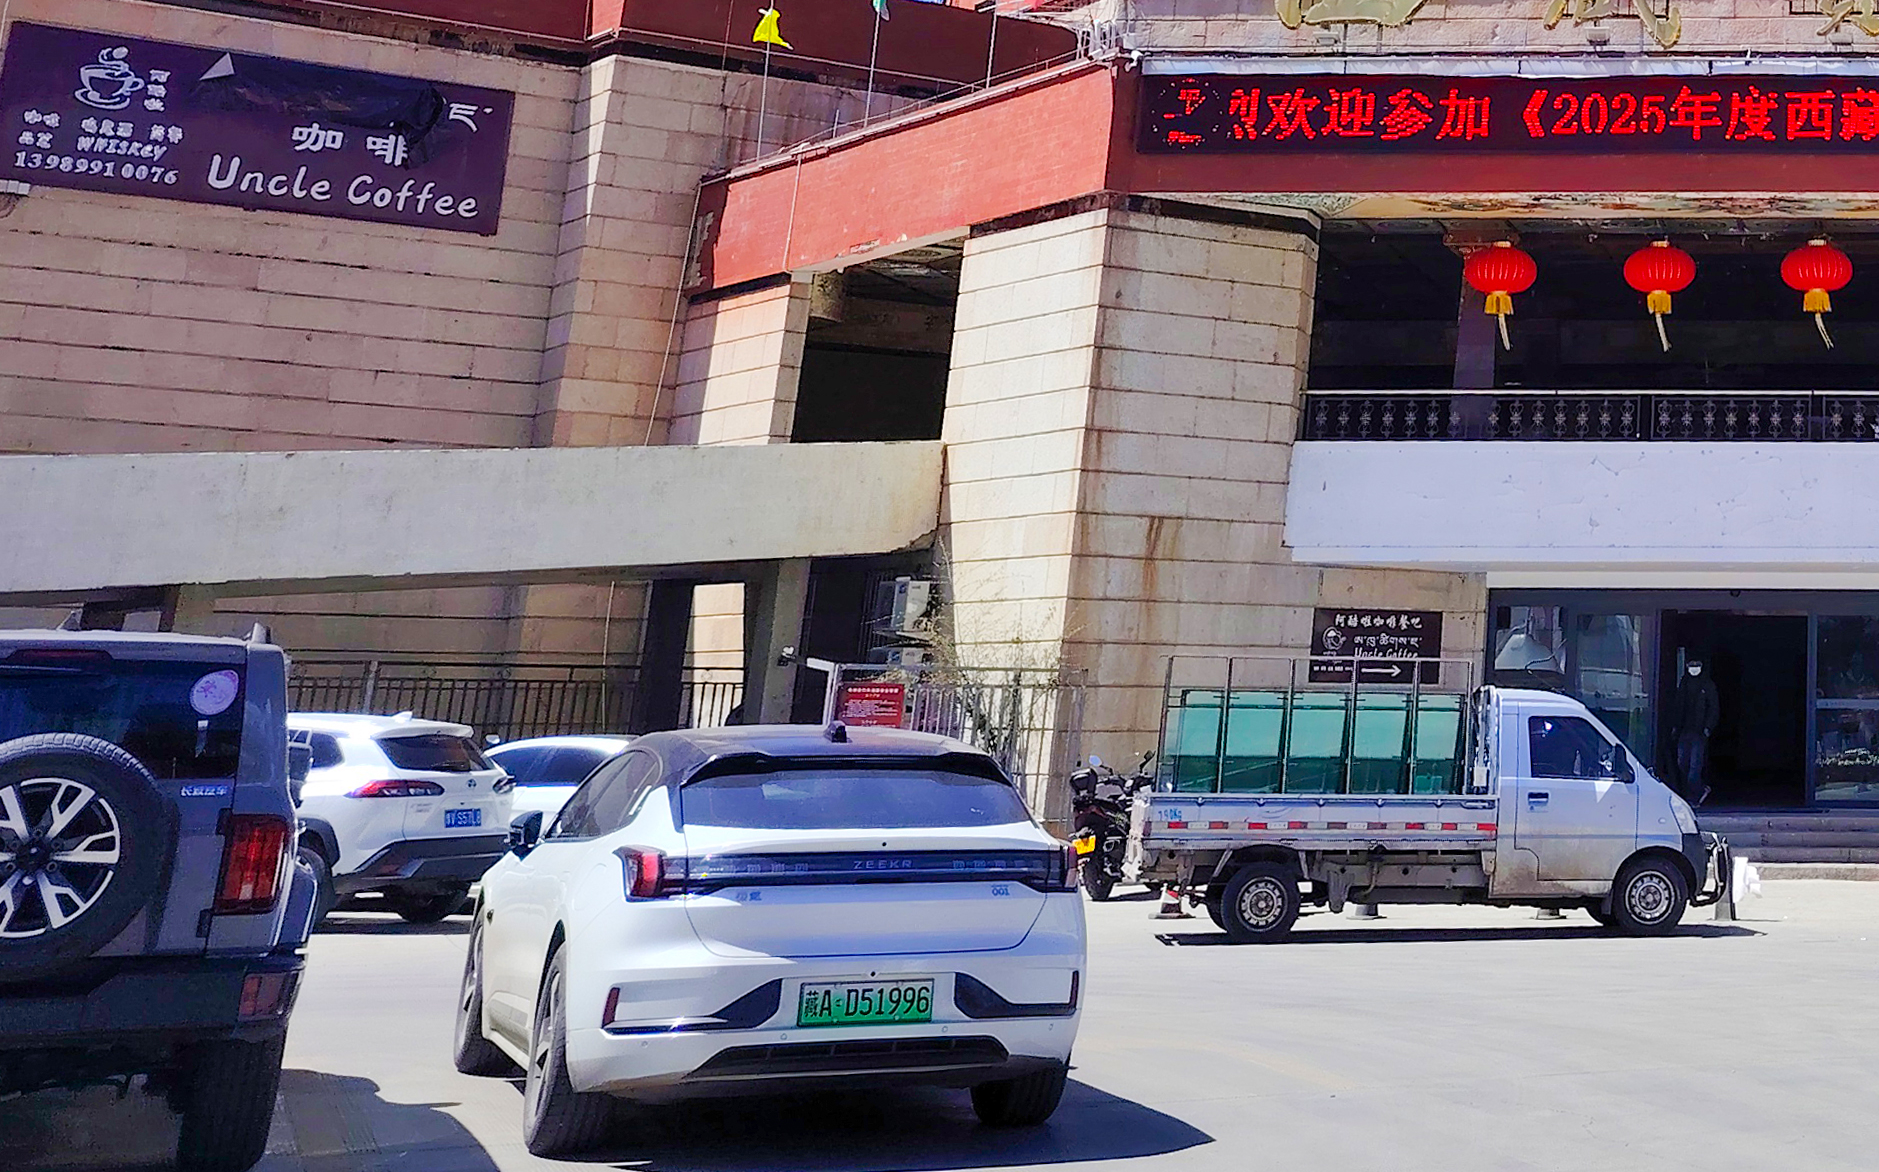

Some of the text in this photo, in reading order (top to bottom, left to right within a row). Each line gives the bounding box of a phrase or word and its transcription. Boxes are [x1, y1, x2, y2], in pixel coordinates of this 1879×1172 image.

[292, 123, 408, 166] 咖啡
[206, 154, 479, 219] Uncle Coffee
[1354, 647, 1384, 658] Uncle
[853, 859, 913, 870] ZEEKR
[991, 887, 1010, 897] 001
